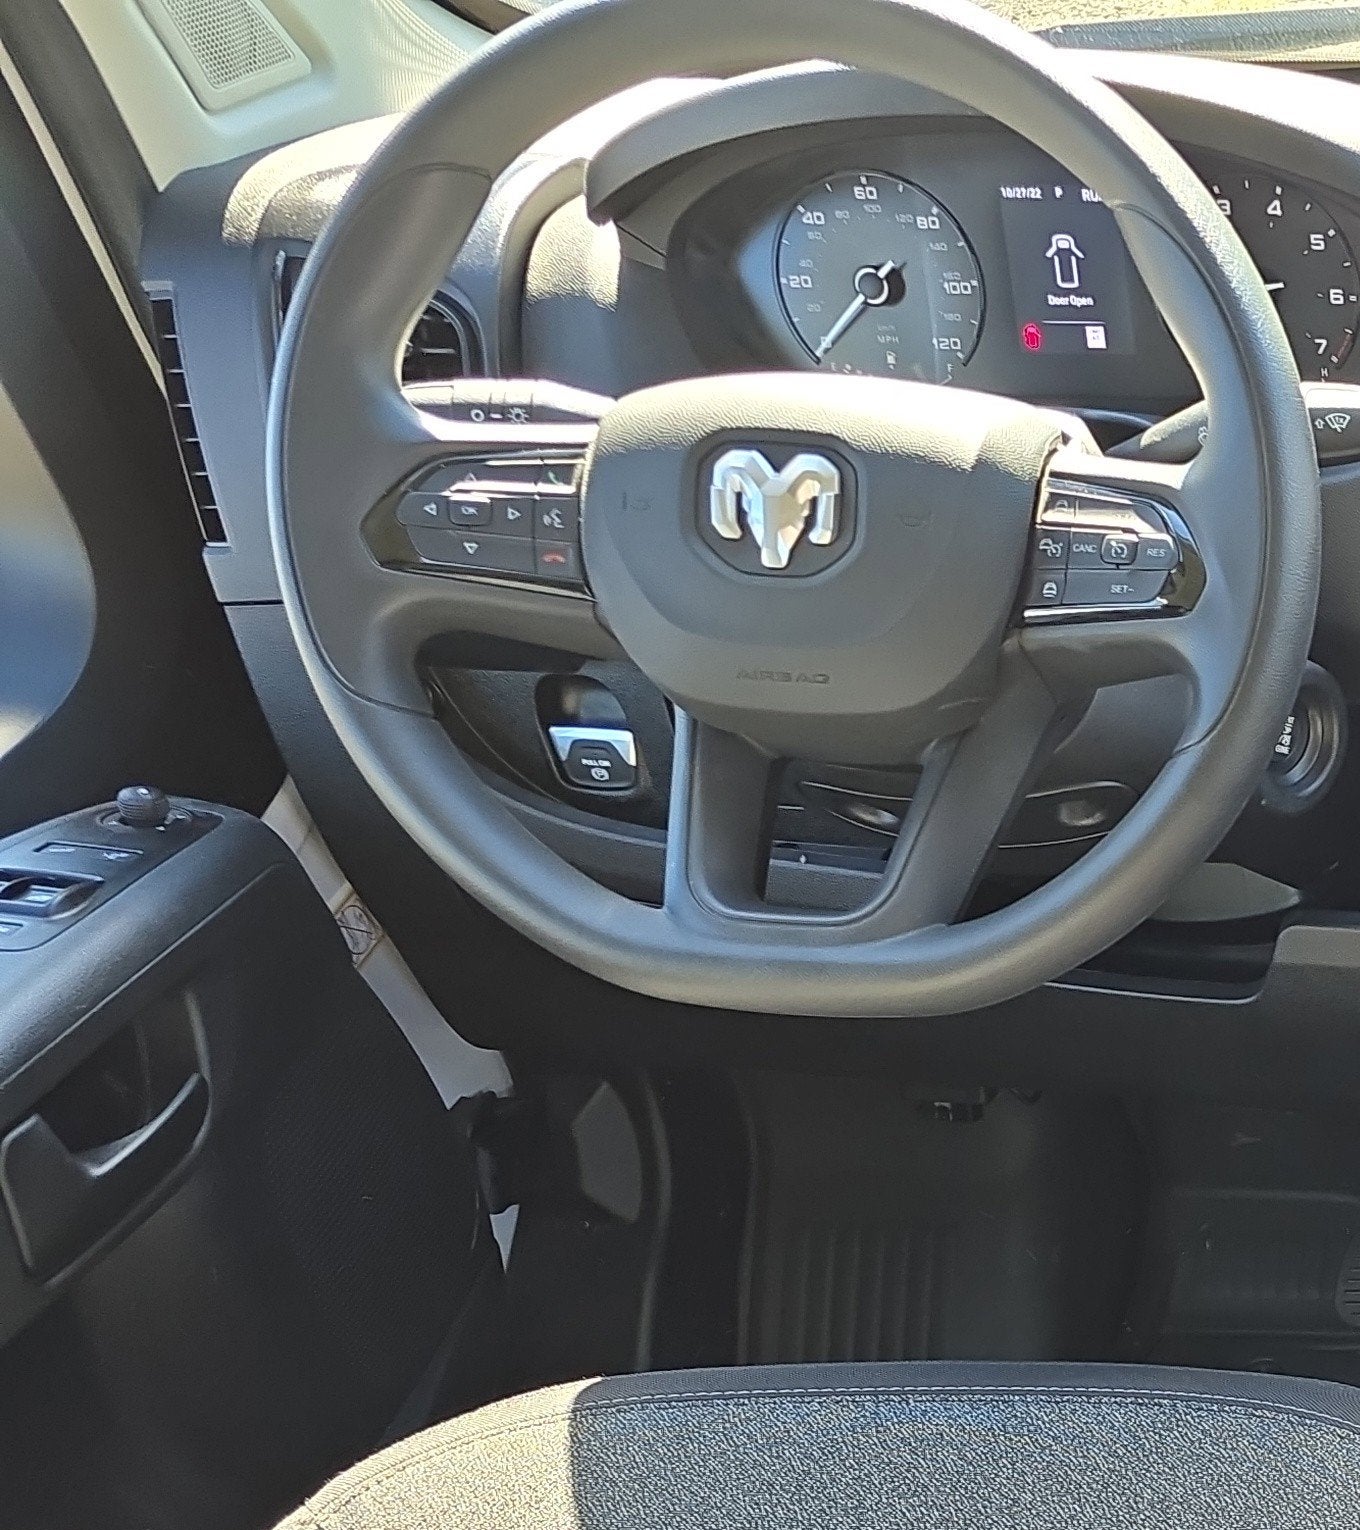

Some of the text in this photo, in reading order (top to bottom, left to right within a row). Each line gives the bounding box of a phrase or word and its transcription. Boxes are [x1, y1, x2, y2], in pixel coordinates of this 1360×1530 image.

[853, 186, 877, 200] 60
[1054, 187, 1063, 198] P
[1217, 199, 1232, 216] 3
[1266, 200, 1283, 217] 4
[802, 212, 825, 225] 40
[916, 216, 940, 230] 80
[1309, 234, 1325, 250] 5
[789, 275, 812, 288] 20
[943, 281, 972, 295] 100
[1047, 295, 1094, 308] Door Open
[1329, 288, 1346, 305] 6
[877, 335, 900, 344] MPH
[932, 337, 961, 350] 120
[1314, 338, 1328, 354] 7
[1321, 367, 1329, 377] H
[1073, 542, 1098, 554] CANC
[1146, 548, 1167, 558] RES
